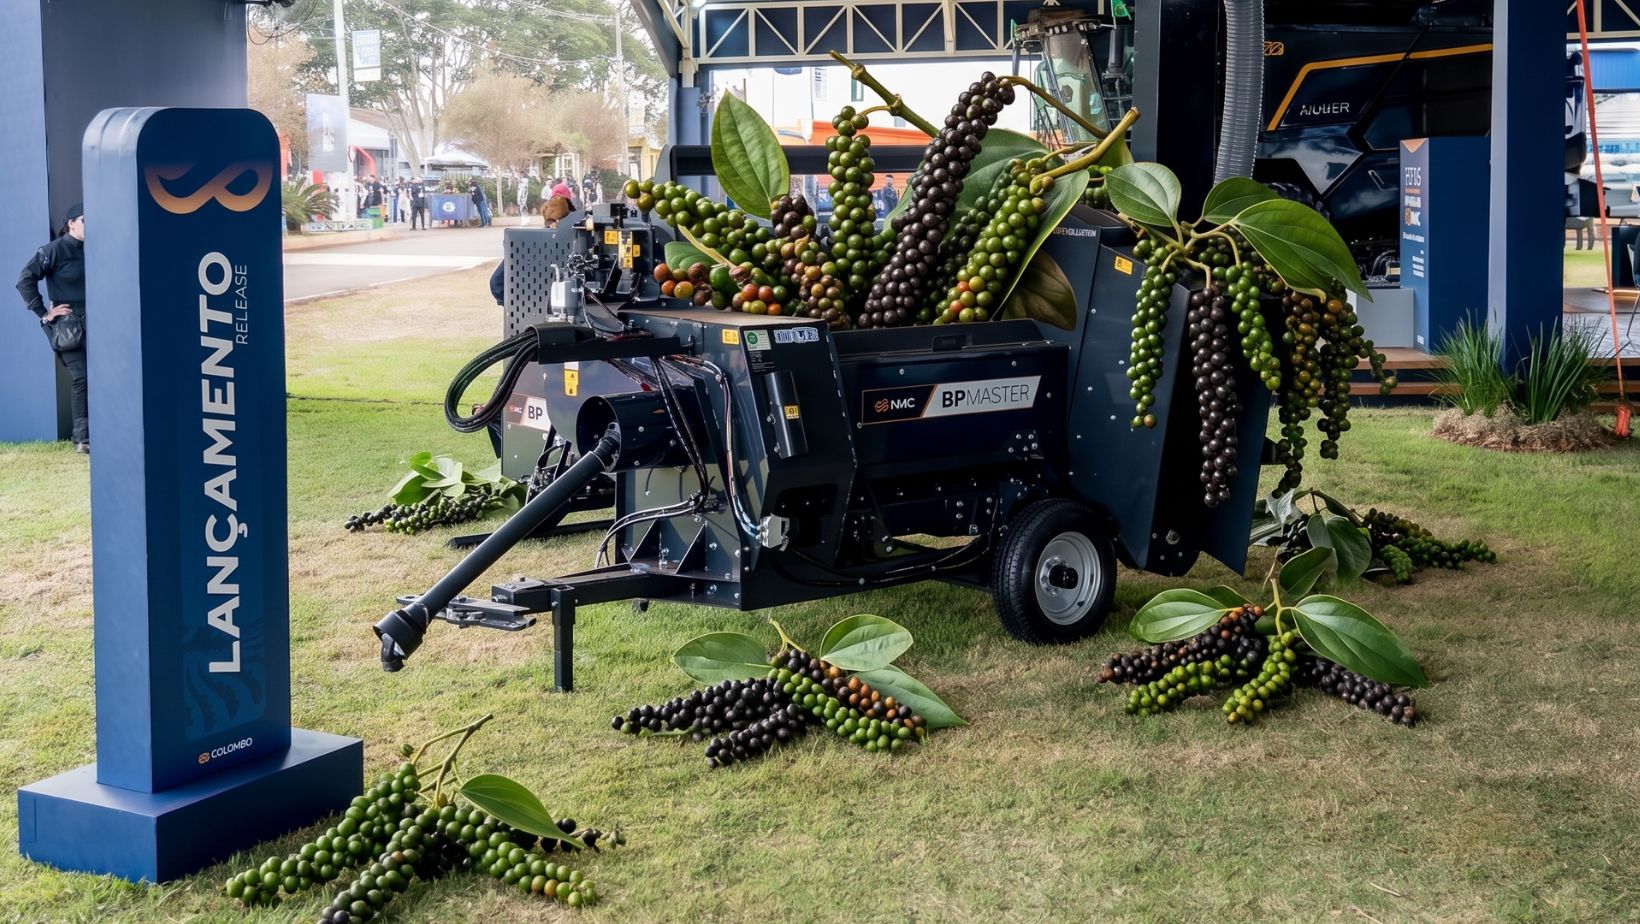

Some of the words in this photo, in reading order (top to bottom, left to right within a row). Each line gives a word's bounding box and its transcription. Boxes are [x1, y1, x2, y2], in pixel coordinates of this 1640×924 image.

[234, 264, 249, 345] RELEASE
[528, 405, 543, 421] BP
[890, 397, 916, 410] NMC
[198, 251, 248, 673] LANÇAMENTO
[211, 737, 253, 759] COLOMBO
